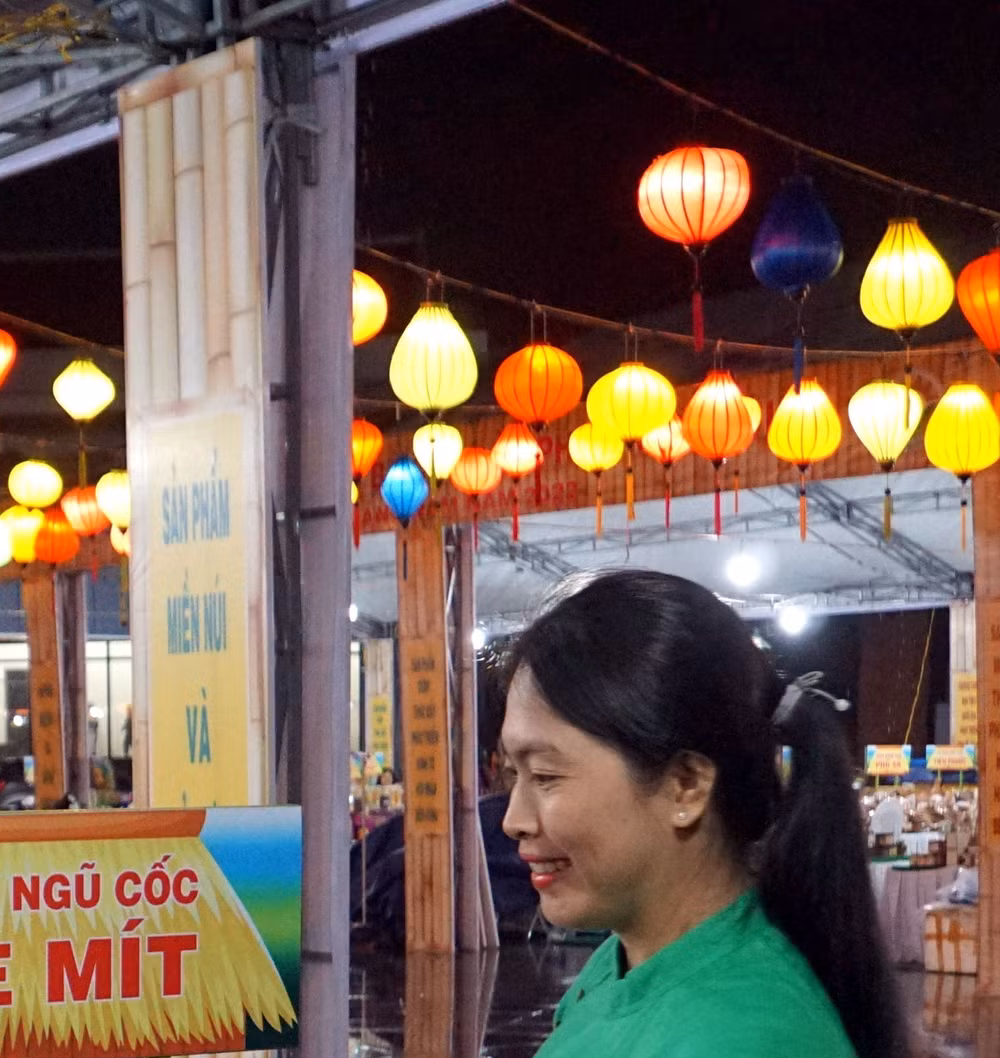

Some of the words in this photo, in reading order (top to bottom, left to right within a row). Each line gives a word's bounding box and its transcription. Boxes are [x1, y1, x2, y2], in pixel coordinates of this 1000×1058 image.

[185, 687, 212, 764] VÀ
[12, 862, 102, 911] NGŨ
[114, 855, 200, 907] CỐC
[46, 918, 199, 1003] MÍT
